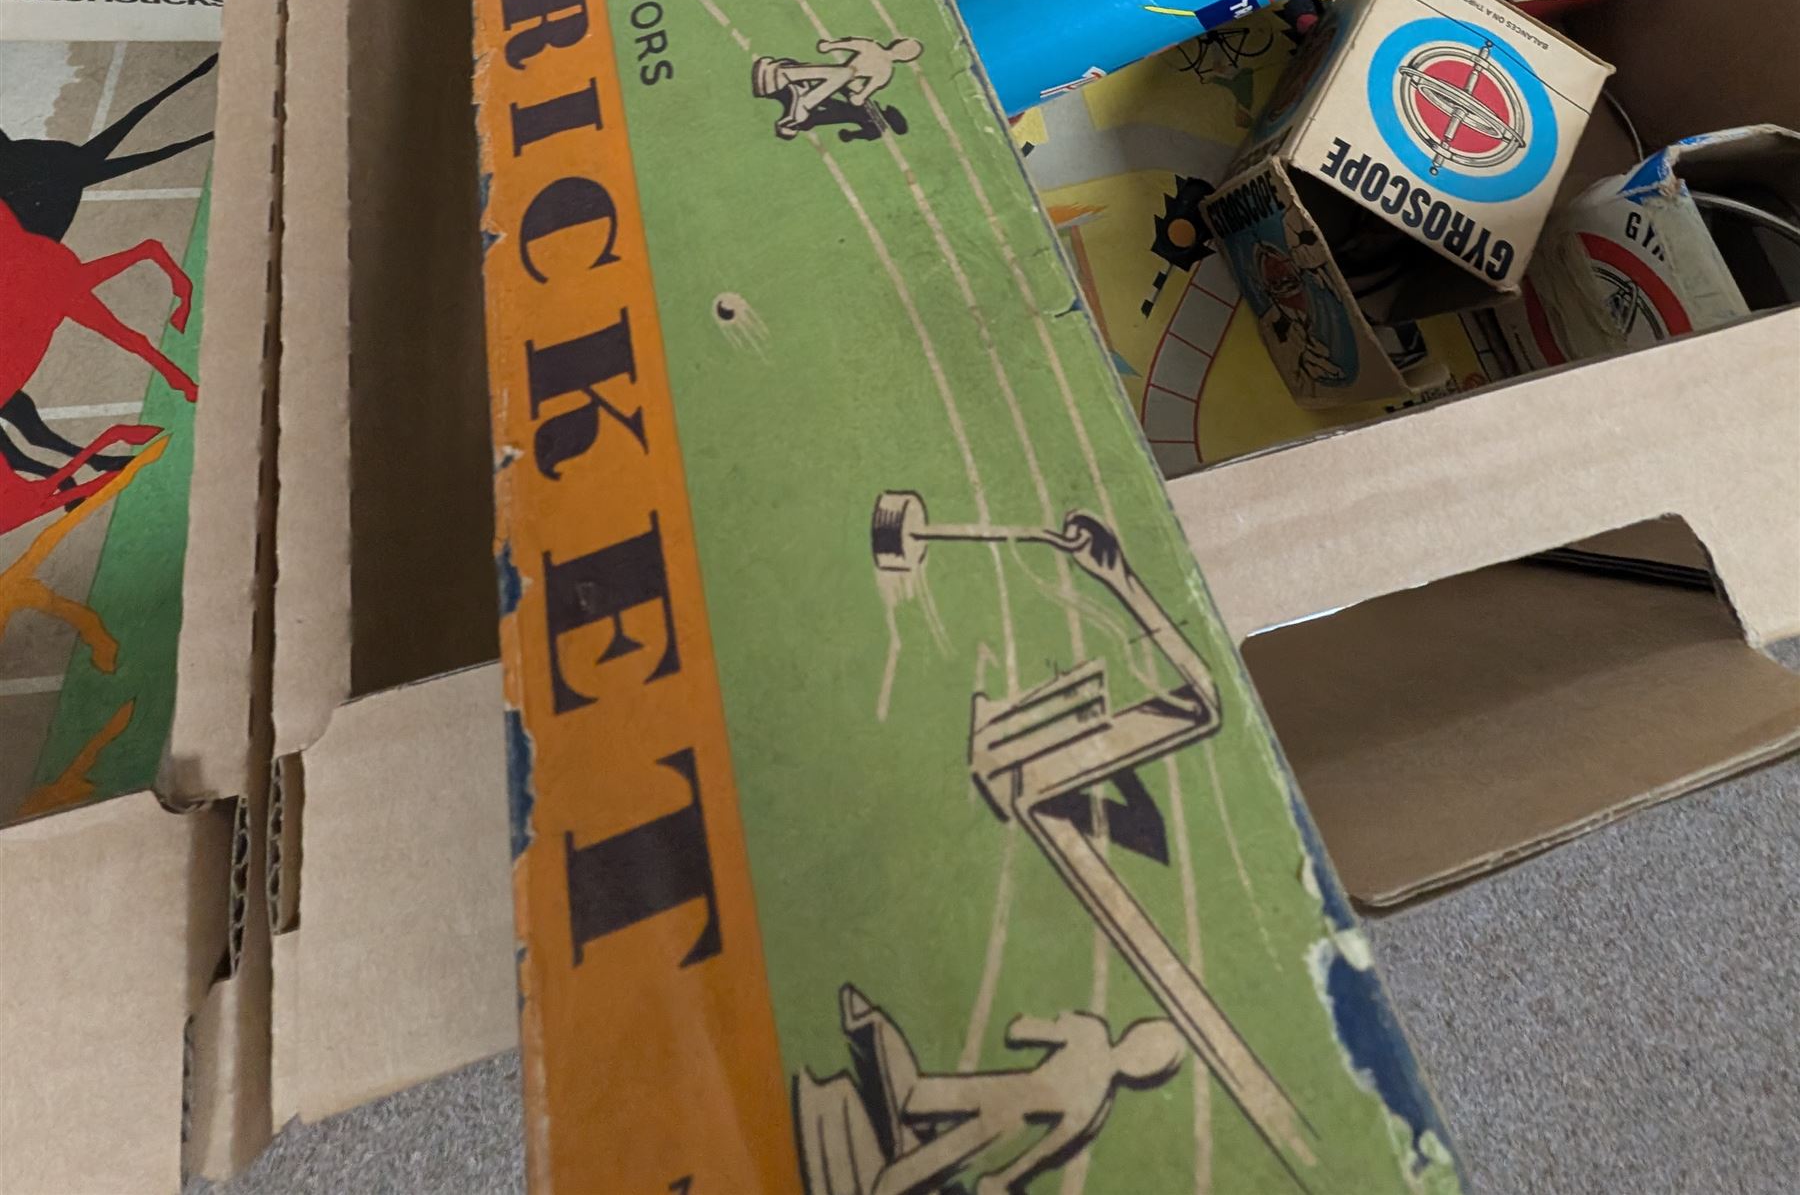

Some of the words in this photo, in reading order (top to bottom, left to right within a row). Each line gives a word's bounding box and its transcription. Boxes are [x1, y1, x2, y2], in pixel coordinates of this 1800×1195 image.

[1491, 13, 1505, 26] ON
[1505, 20, 1549, 50] BALANCES
[1320, 137, 1516, 282] GYROSCOPE
